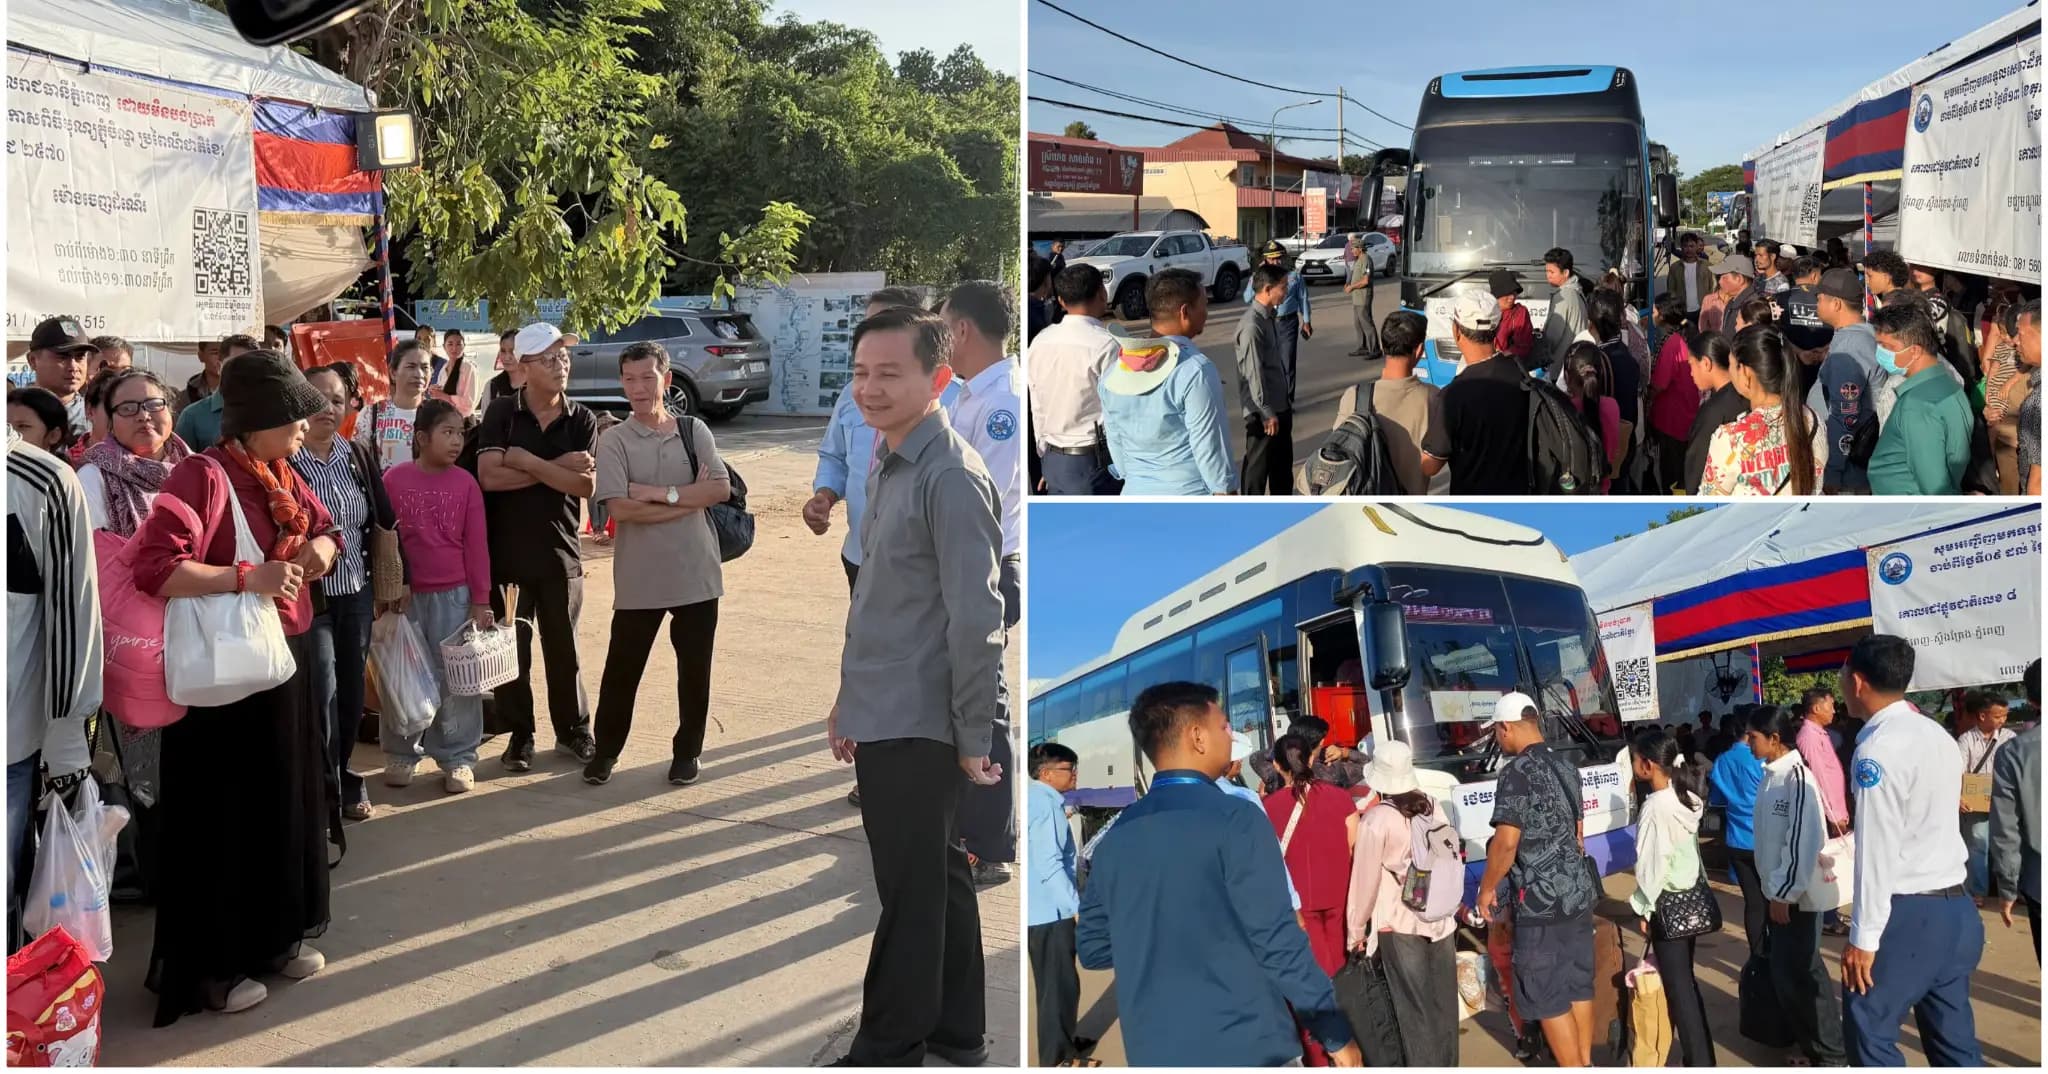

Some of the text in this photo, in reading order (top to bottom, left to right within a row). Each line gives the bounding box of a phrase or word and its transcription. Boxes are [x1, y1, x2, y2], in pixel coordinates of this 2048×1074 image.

[7, 107, 135, 149] កាសពិធីបុណ្យភ្ជុំបិណ្ឌ
[2013, 257, 2026, 270] 081
[84, 315, 105, 329] 515
[2005, 542, 2028, 558] ដល់
[2006, 588, 2017, 601] ៨
